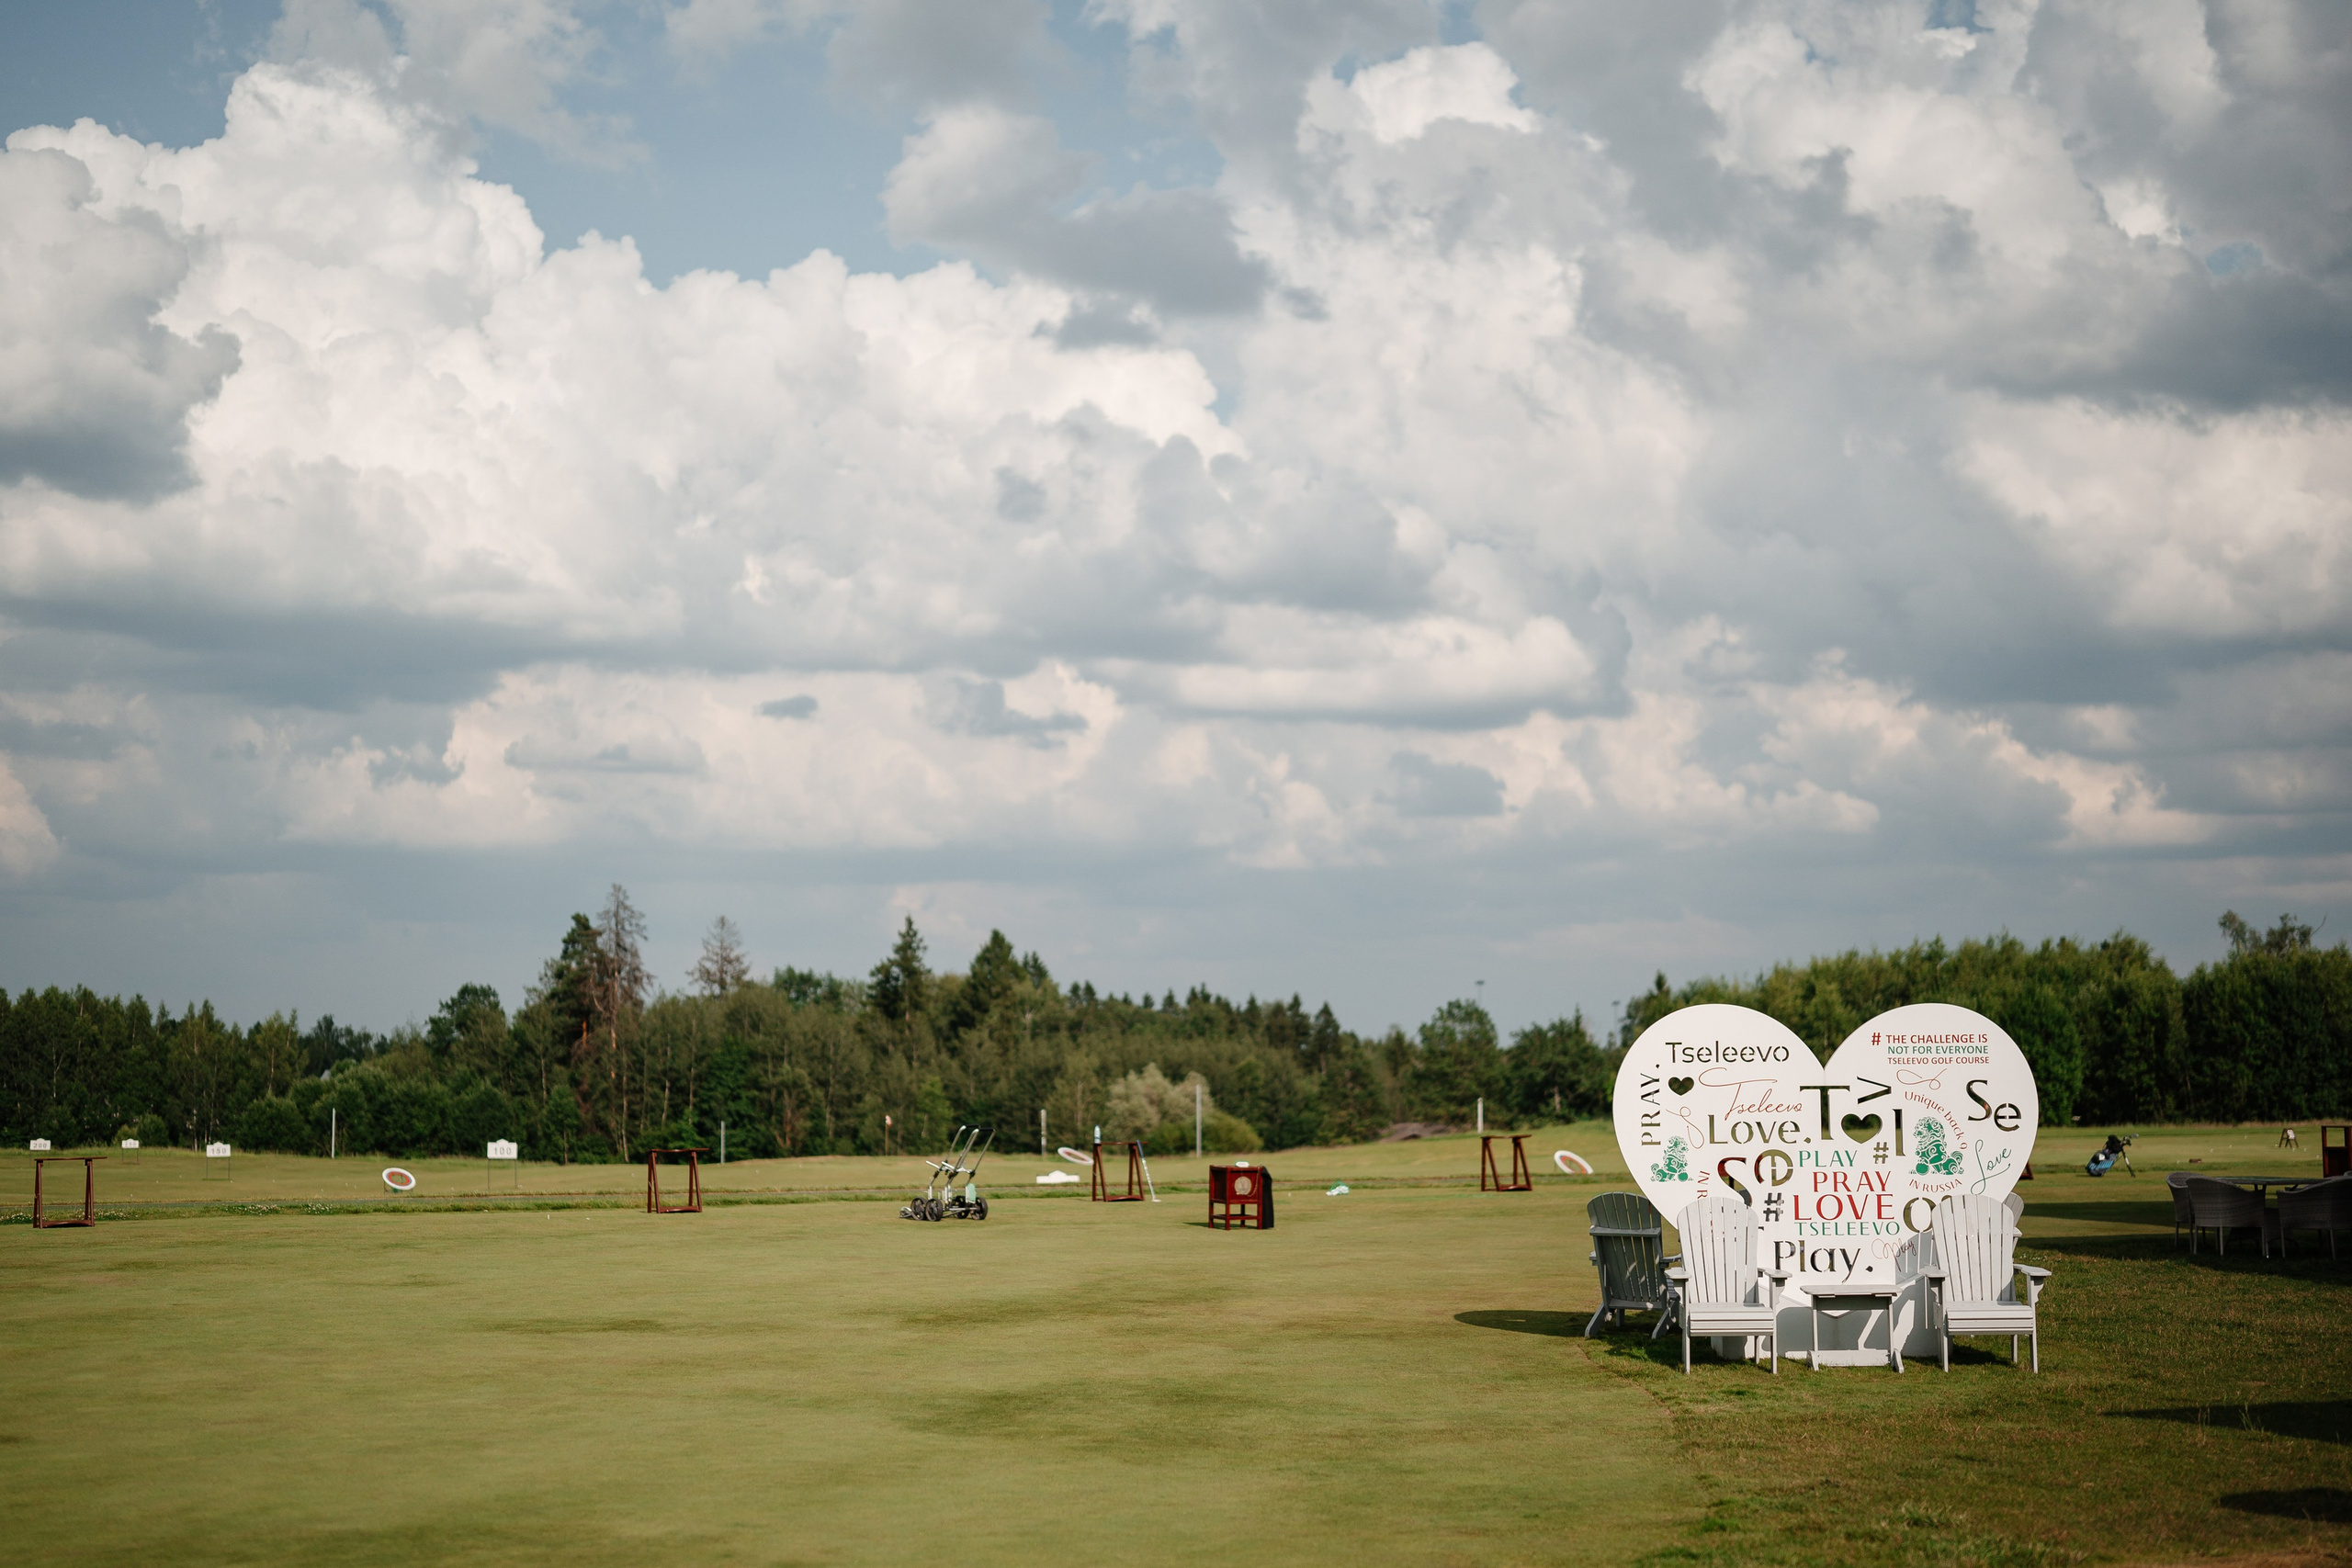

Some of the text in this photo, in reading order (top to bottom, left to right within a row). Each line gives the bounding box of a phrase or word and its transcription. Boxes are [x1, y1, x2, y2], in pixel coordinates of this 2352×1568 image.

[1885, 1034, 1907, 1044] THE
[1910, 1033, 1975, 1044] CHALLENGE
[1978, 1033, 1988, 1043] IS
[1665, 1040, 1790, 1064] Tseleevo
[1887, 1045, 1989, 1055] NOT FOR EVERYONE
[1887, 1056, 1990, 1065] TSELEEVO GOLF COURSE
[1699, 1066, 1803, 1121] Tseleevo
[1905, 1090, 1946, 1114] Unique
[1943, 1111, 1965, 1141] back
[1707, 1113, 1812, 1145] Love.
[494, 1146, 512, 1156] 100
[1798, 1149, 1858, 1168] PLAY
[1970, 1139, 2012, 1195] Love
[1812, 1170, 1892, 1192] PRAY
[1908, 1179, 1963, 1193] IN RUSSIA
[1792, 1194, 1895, 1221] LOVE
[1794, 1221, 1900, 1236] TSELEEVO
[1773, 1239, 1874, 1284] Play.
